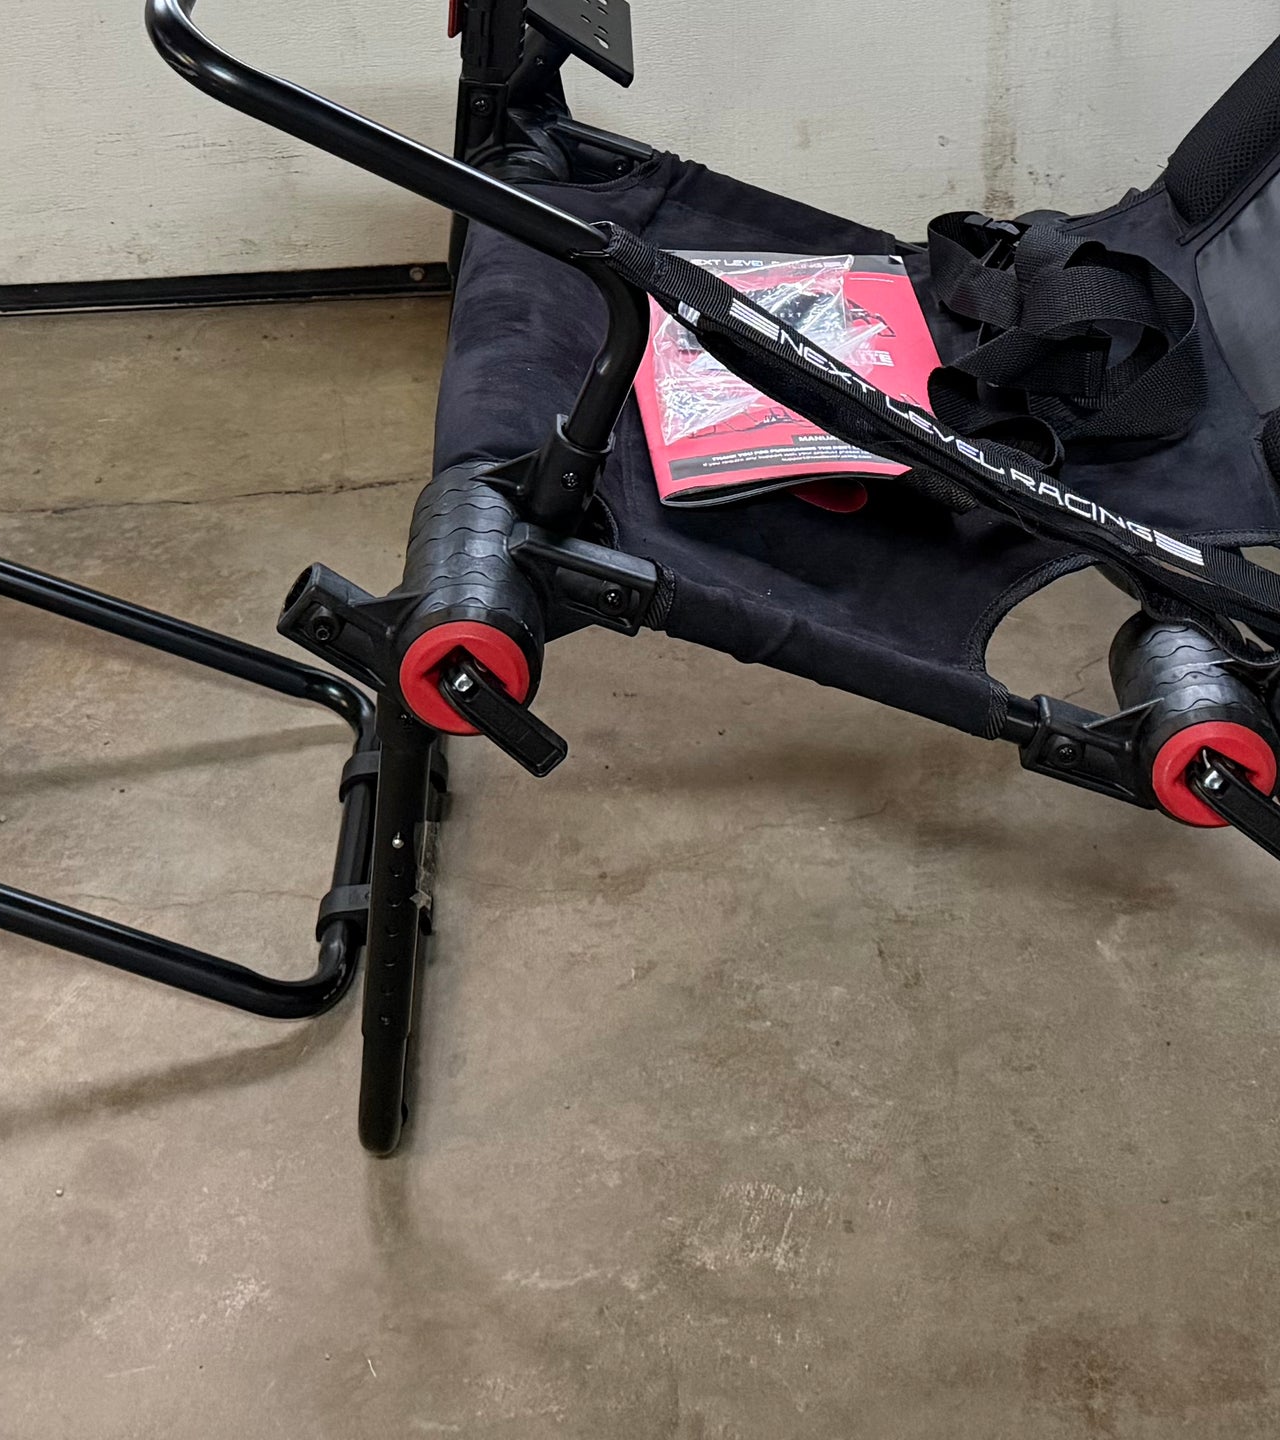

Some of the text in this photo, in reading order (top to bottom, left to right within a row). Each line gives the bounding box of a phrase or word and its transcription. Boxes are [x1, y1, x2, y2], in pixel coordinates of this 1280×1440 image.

[780, 329, 1154, 543] NEXT LEVEL RACING
